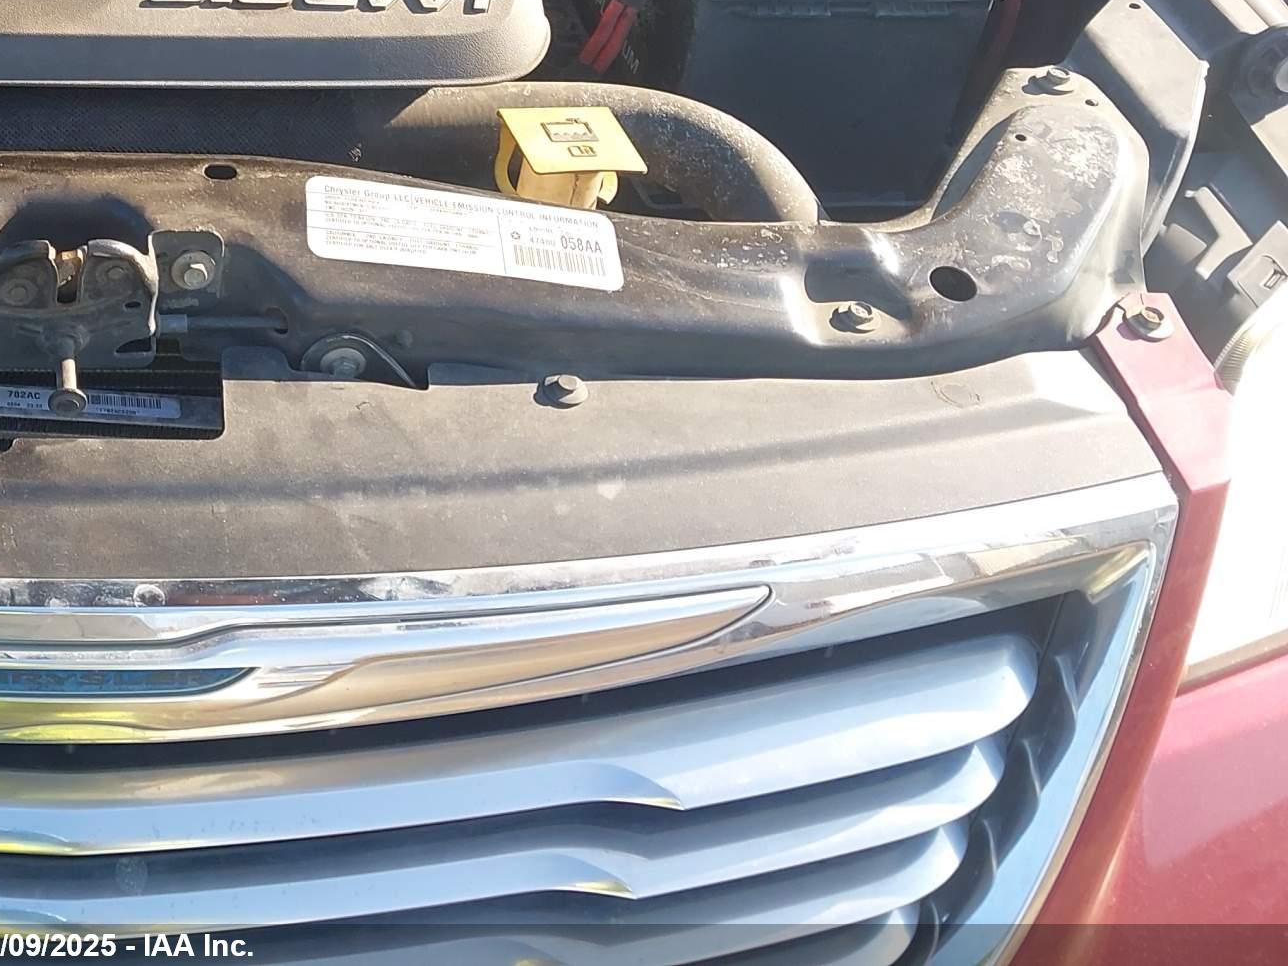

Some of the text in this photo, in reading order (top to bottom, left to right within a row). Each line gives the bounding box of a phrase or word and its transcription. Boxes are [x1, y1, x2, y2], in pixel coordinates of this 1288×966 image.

[324, 185, 360, 196] Chrysler
[364, 189, 390, 201] Group
[394, 194, 410, 203] LLC
[414, 196, 448, 208] VEHICLE
[453, 202, 494, 214] EMISSION
[497, 208, 536, 220] CONTROL
[539, 213, 599, 228] INFORMATION
[561, 235, 602, 254] 058AA
